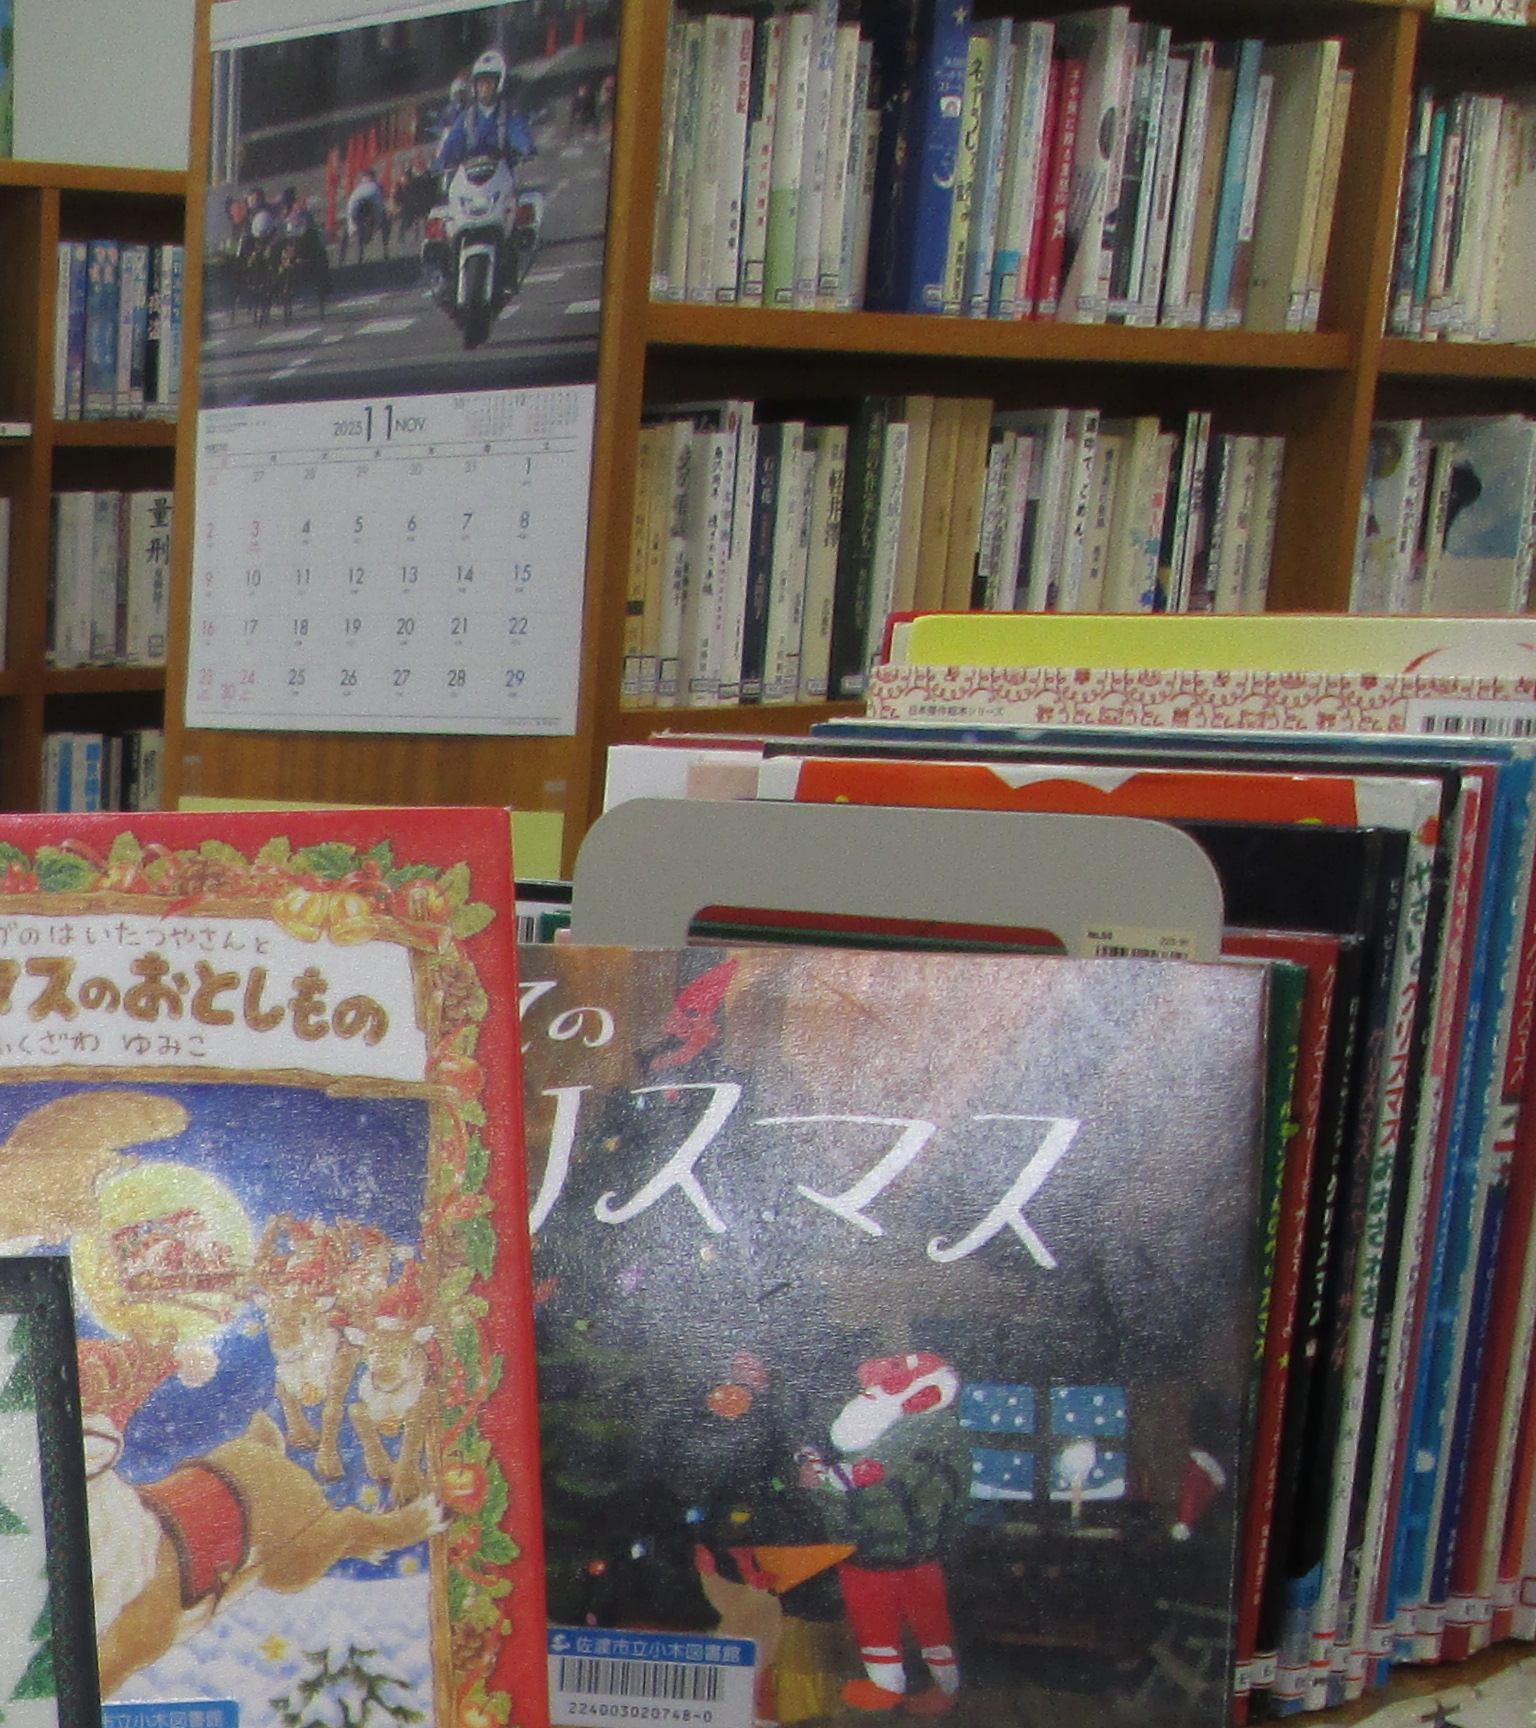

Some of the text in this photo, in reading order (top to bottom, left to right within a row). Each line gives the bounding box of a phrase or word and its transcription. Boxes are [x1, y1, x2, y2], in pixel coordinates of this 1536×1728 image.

[364, 405, 392, 442] 11
[207, 511, 530, 539] 2 3 4 5 6 7 8
[205, 564, 531, 587] 9 10 11 12 13 14 15
[201, 617, 528, 637] 16 17 18 19 20 21 22
[288, 669, 305, 686] 25
[340, 670, 358, 686] 26
[394, 670, 411, 686] 27
[447, 670, 465, 687] 28
[506, 670, 525, 687] 29
[122, 1031, 207, 1059] ゆみこ
[576, 1636, 741, 1662] 佐渡市立小木図書館
[568, 1702, 713, 1723] 224003020748-0
